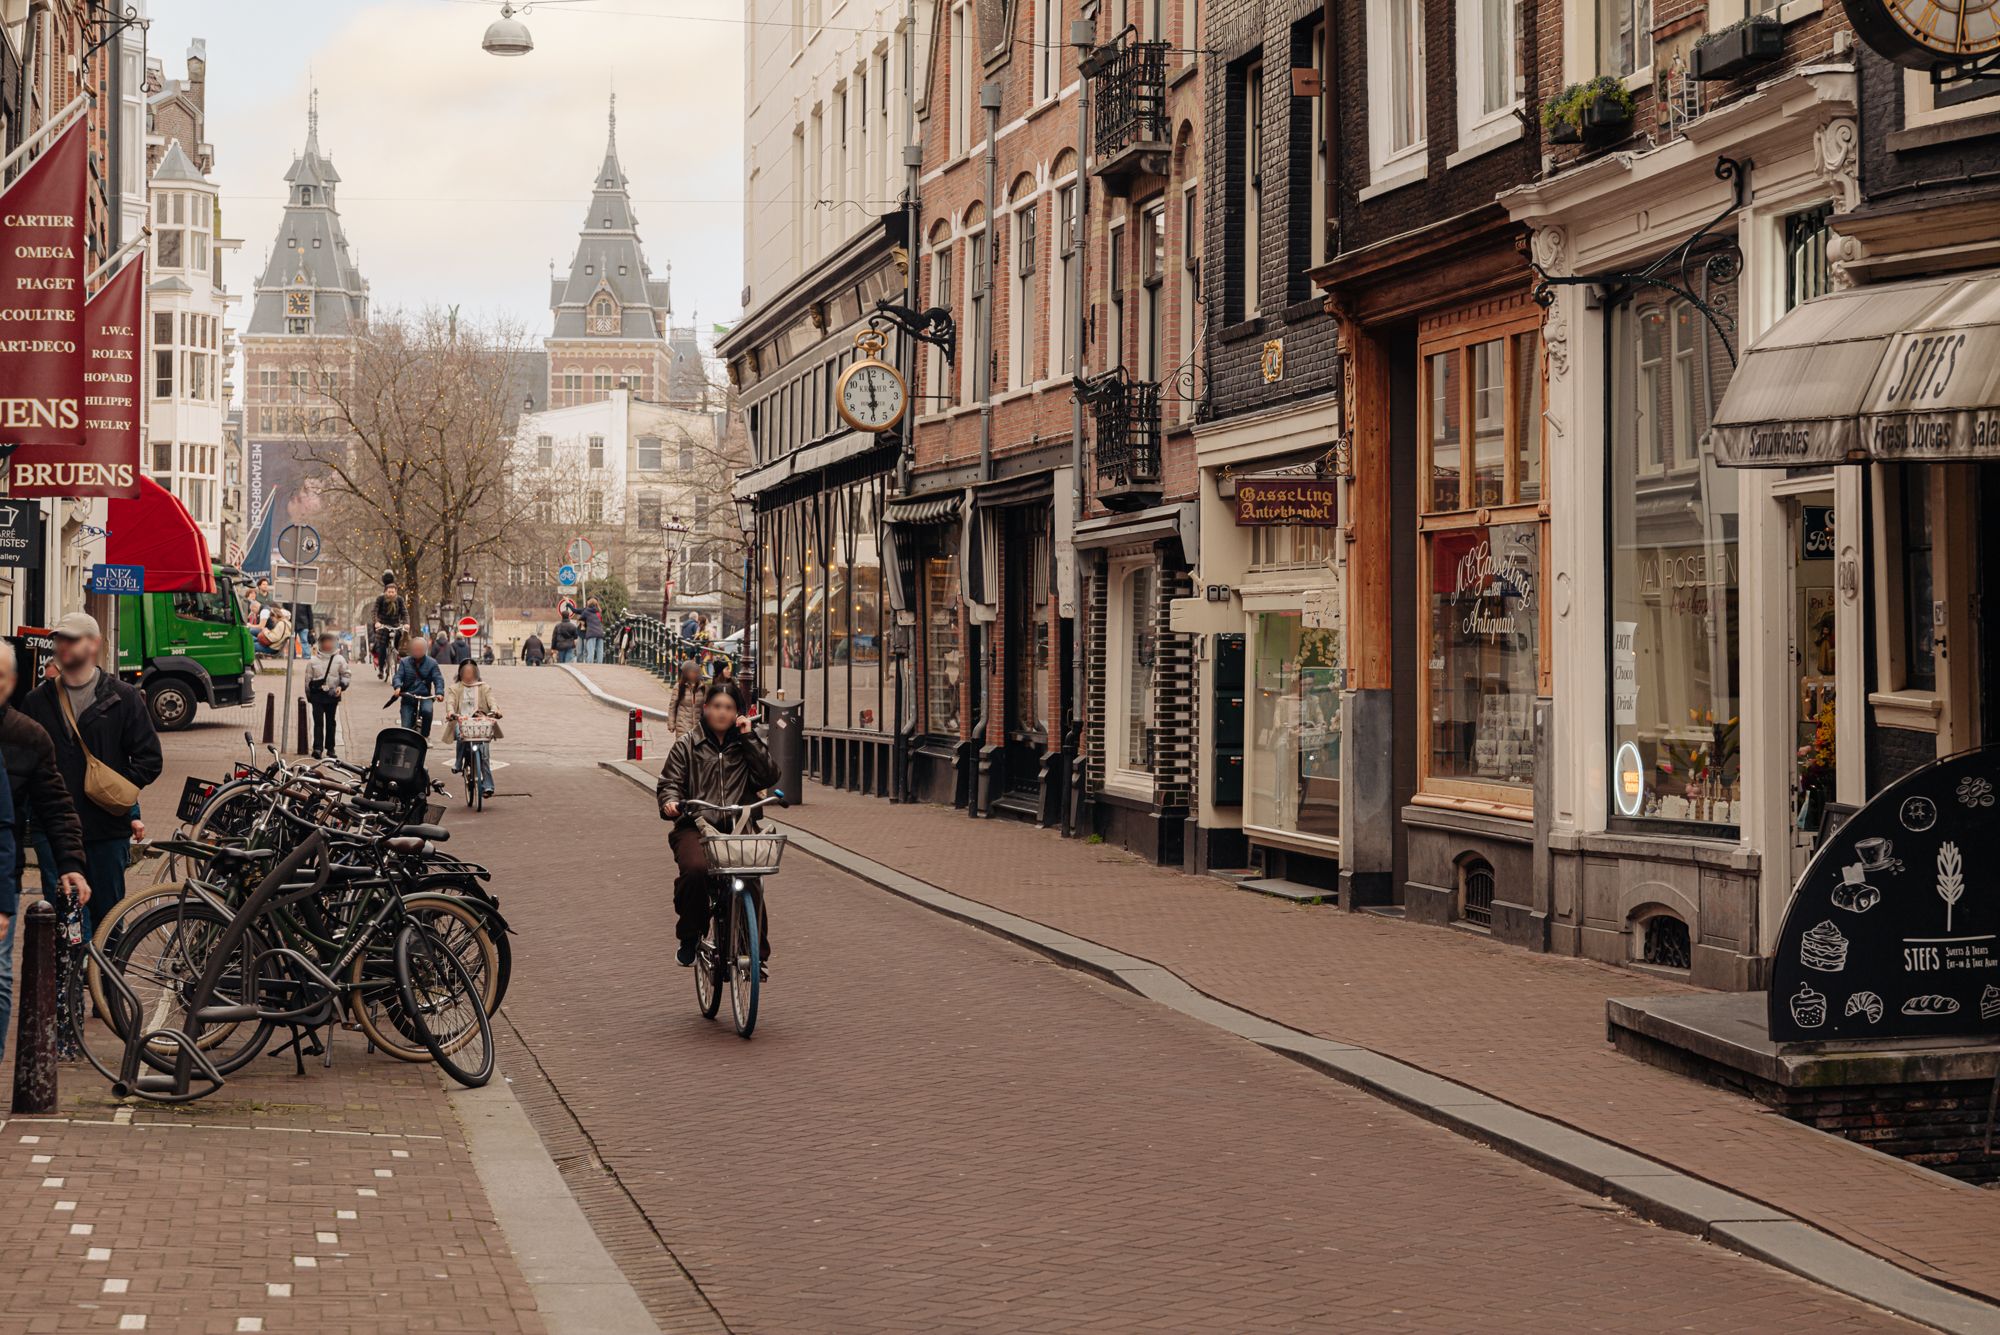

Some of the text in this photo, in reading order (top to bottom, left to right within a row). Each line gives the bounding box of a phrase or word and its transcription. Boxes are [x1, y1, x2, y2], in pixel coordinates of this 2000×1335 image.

[4, 215, 75, 227] CARTIER
[15, 246, 75, 259] OMEGA
[16, 278, 75, 290] PIAGET
[101, 326, 134, 336] I.W.C.
[92, 349, 133, 360] ROLEX
[1887, 334, 1966, 402] STEFS
[84, 373, 132, 383] HOPARD
[860, 385, 887, 393] KRMER
[85, 397, 132, 407] HILIPPE
[0, 398, 79, 429] ENS
[86, 420, 131, 430] WELRY
[1874, 419, 1908, 450] Fresh
[1912, 417, 1951, 448] Juices
[1749, 427, 1809, 456] Sandwiches
[14, 463, 134, 487] BRUENS
[105, 568, 131, 578] INEZ
[96, 577, 140, 588] STODEL
[1463, 599, 1516, 645] Antiquair
[1615, 634, 1631, 650] HOT
[1615, 666, 1633, 680] Choco
[1616, 696, 1633, 710] Drink
[1904, 947, 1940, 972] STEFS
[1966, 946, 1971, 957] &
[1966, 959, 1971, 969] &
